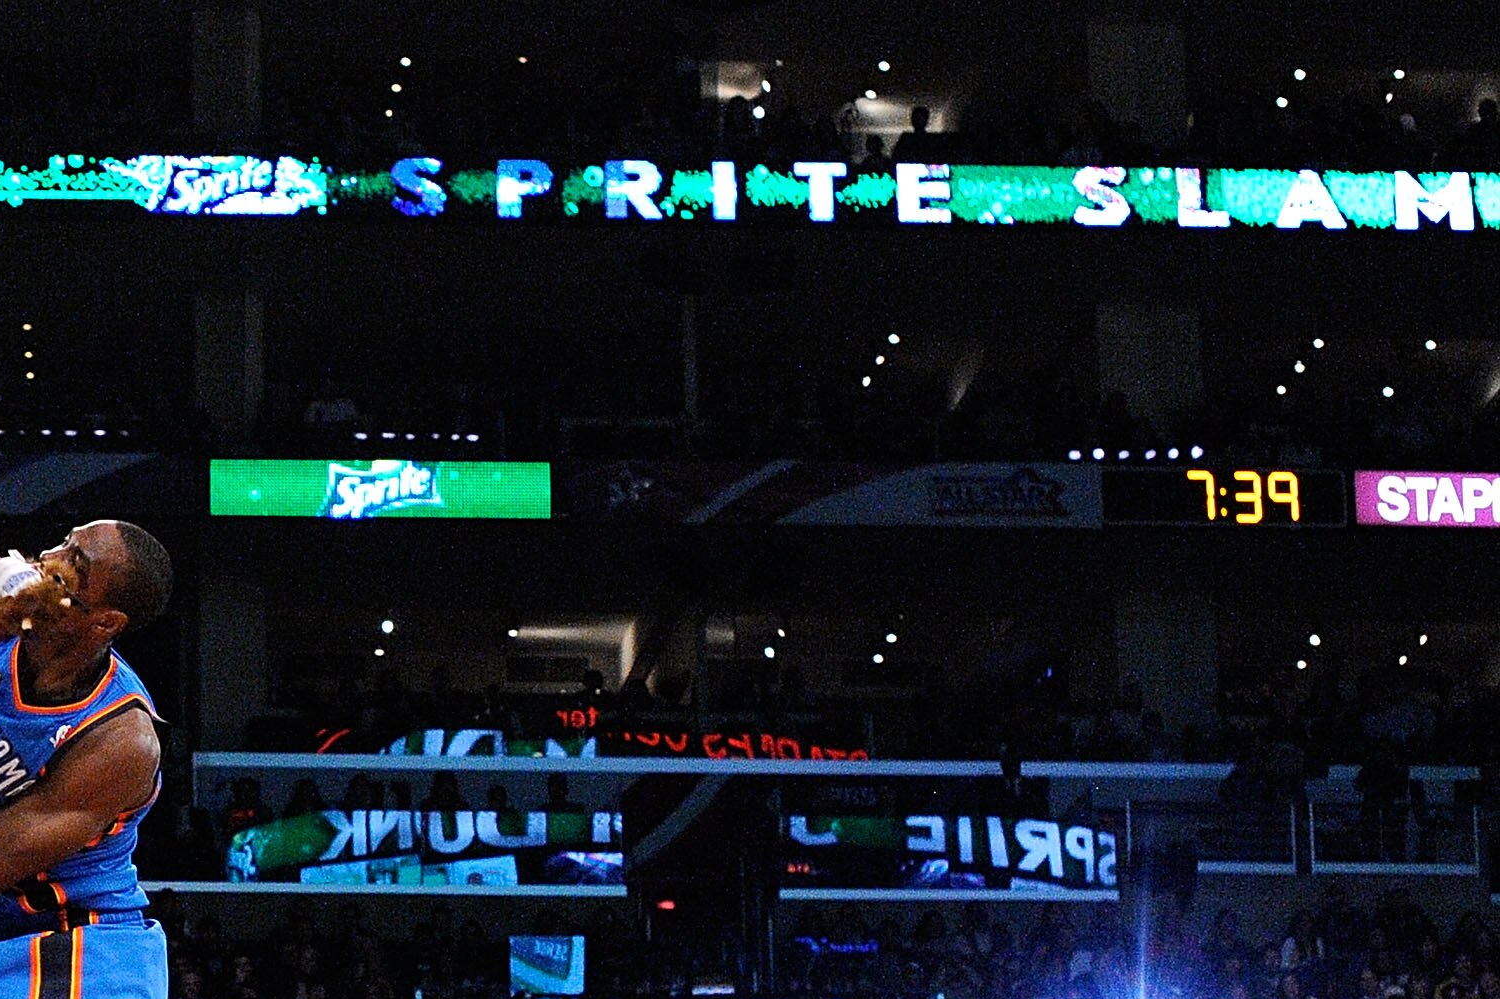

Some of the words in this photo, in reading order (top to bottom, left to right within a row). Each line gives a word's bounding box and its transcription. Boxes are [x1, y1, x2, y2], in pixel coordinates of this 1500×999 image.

[163, 154, 273, 215] Sprite
[389, 157, 952, 223] SPRITE
[1072, 165, 1476, 231] SLAM
[331, 459, 432, 519] Sprite
[1186, 469, 1301, 524] 7:39
